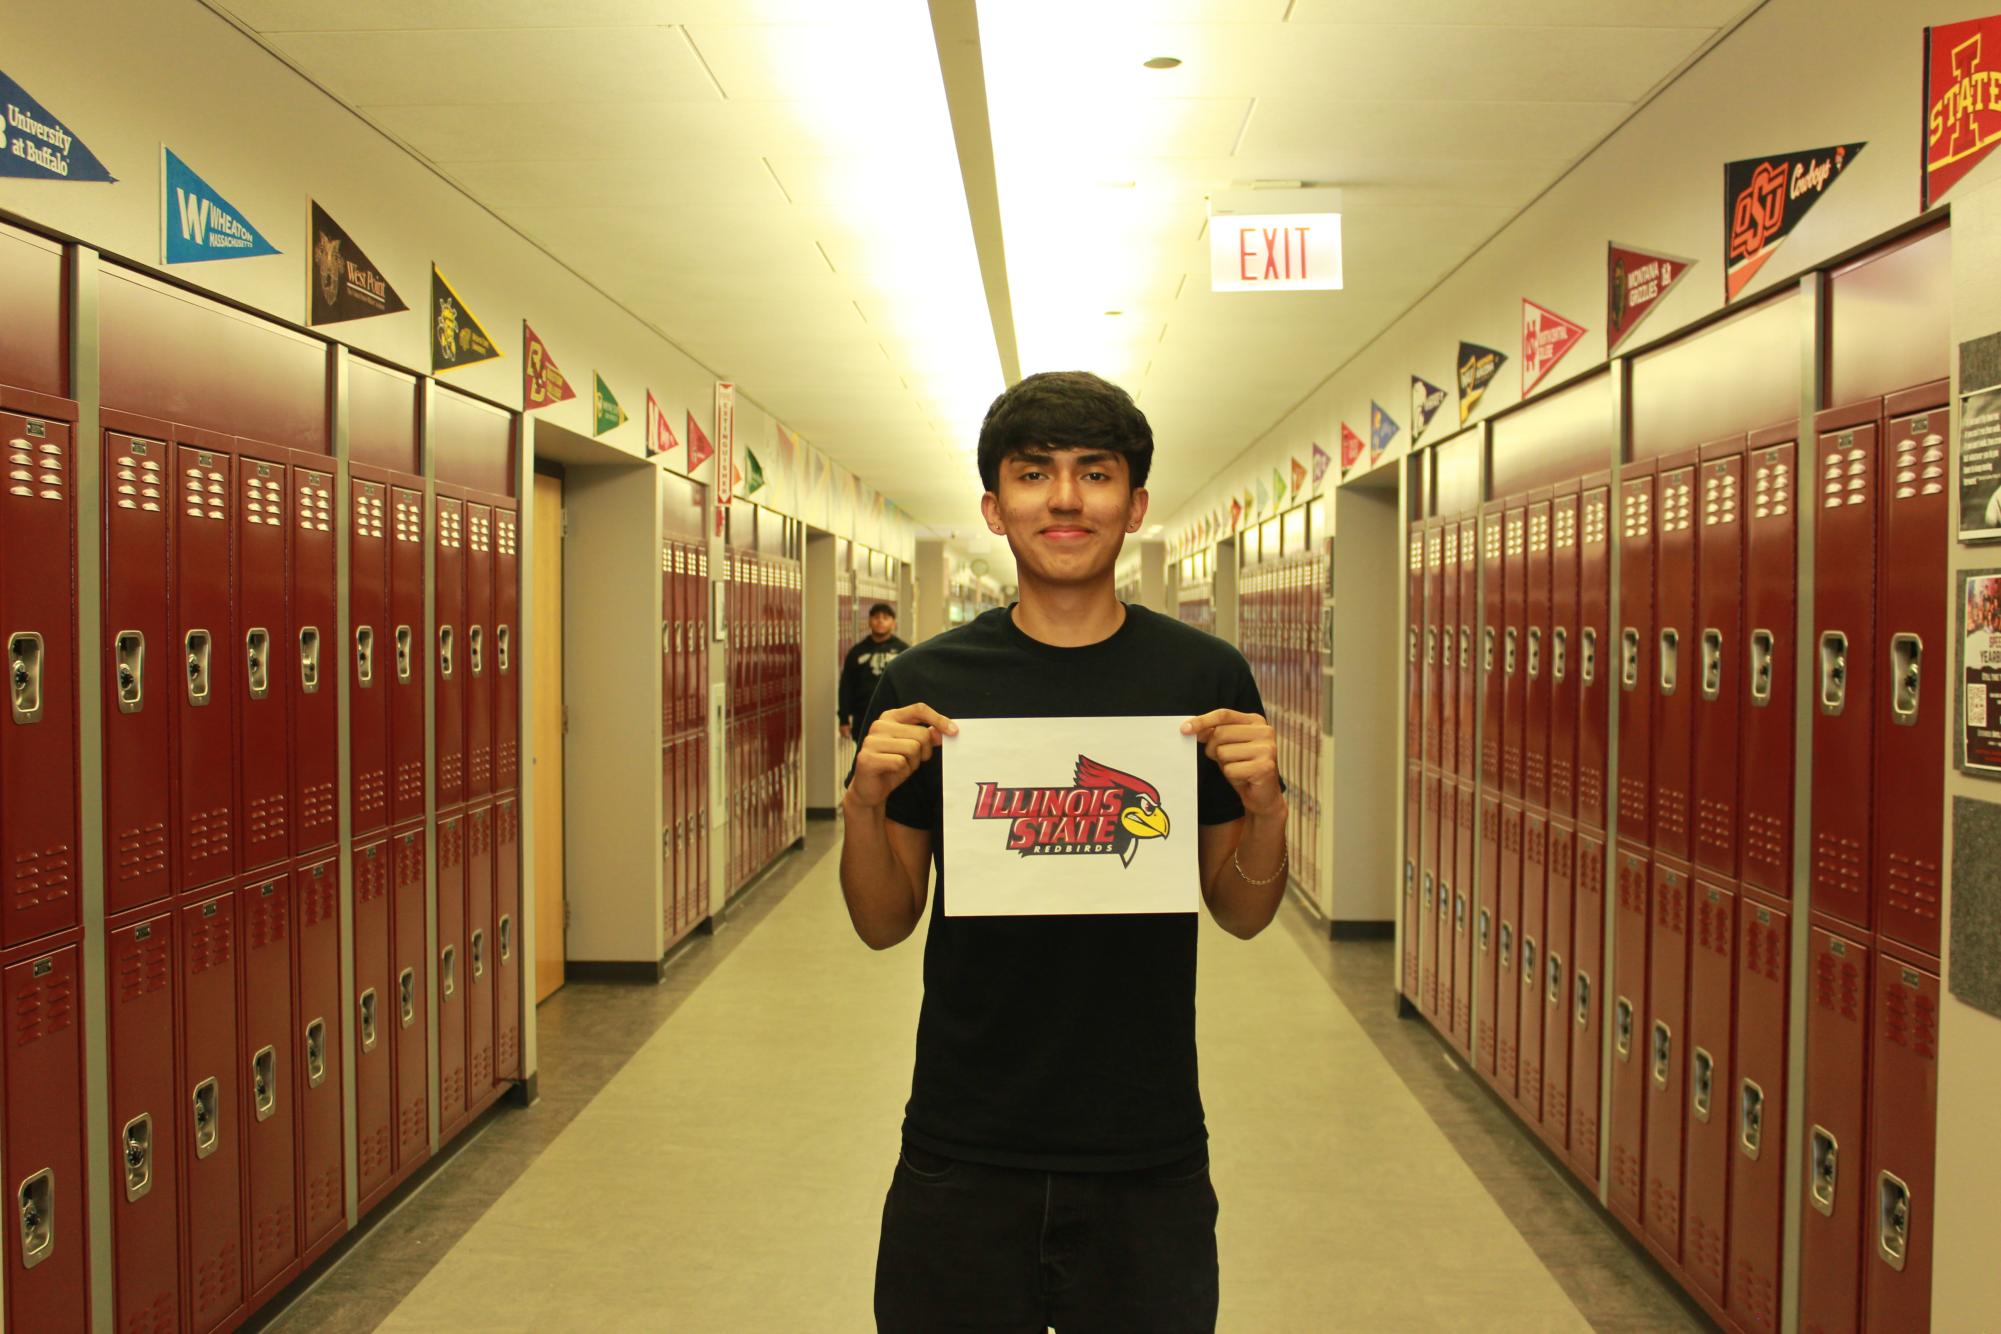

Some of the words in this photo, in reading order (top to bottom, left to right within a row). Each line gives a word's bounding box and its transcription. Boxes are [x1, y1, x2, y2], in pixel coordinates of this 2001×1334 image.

[7, 103, 72, 156] University
[12, 138, 26, 158] at
[26, 139, 69, 177] Buffalo
[1790, 158, 1832, 200] Cowboys
[208, 231, 254, 248] MASSACHUSETTS
[209, 201, 253, 242] WHEATON
[1240, 227, 1311, 280] EXIT
[346, 260, 367, 288] West
[367, 270, 386, 299] Point
[973, 782, 1125, 819] ILLINOIS
[1009, 815, 1119, 849] STATE
[1033, 844, 1114, 854] REDBIRDS
